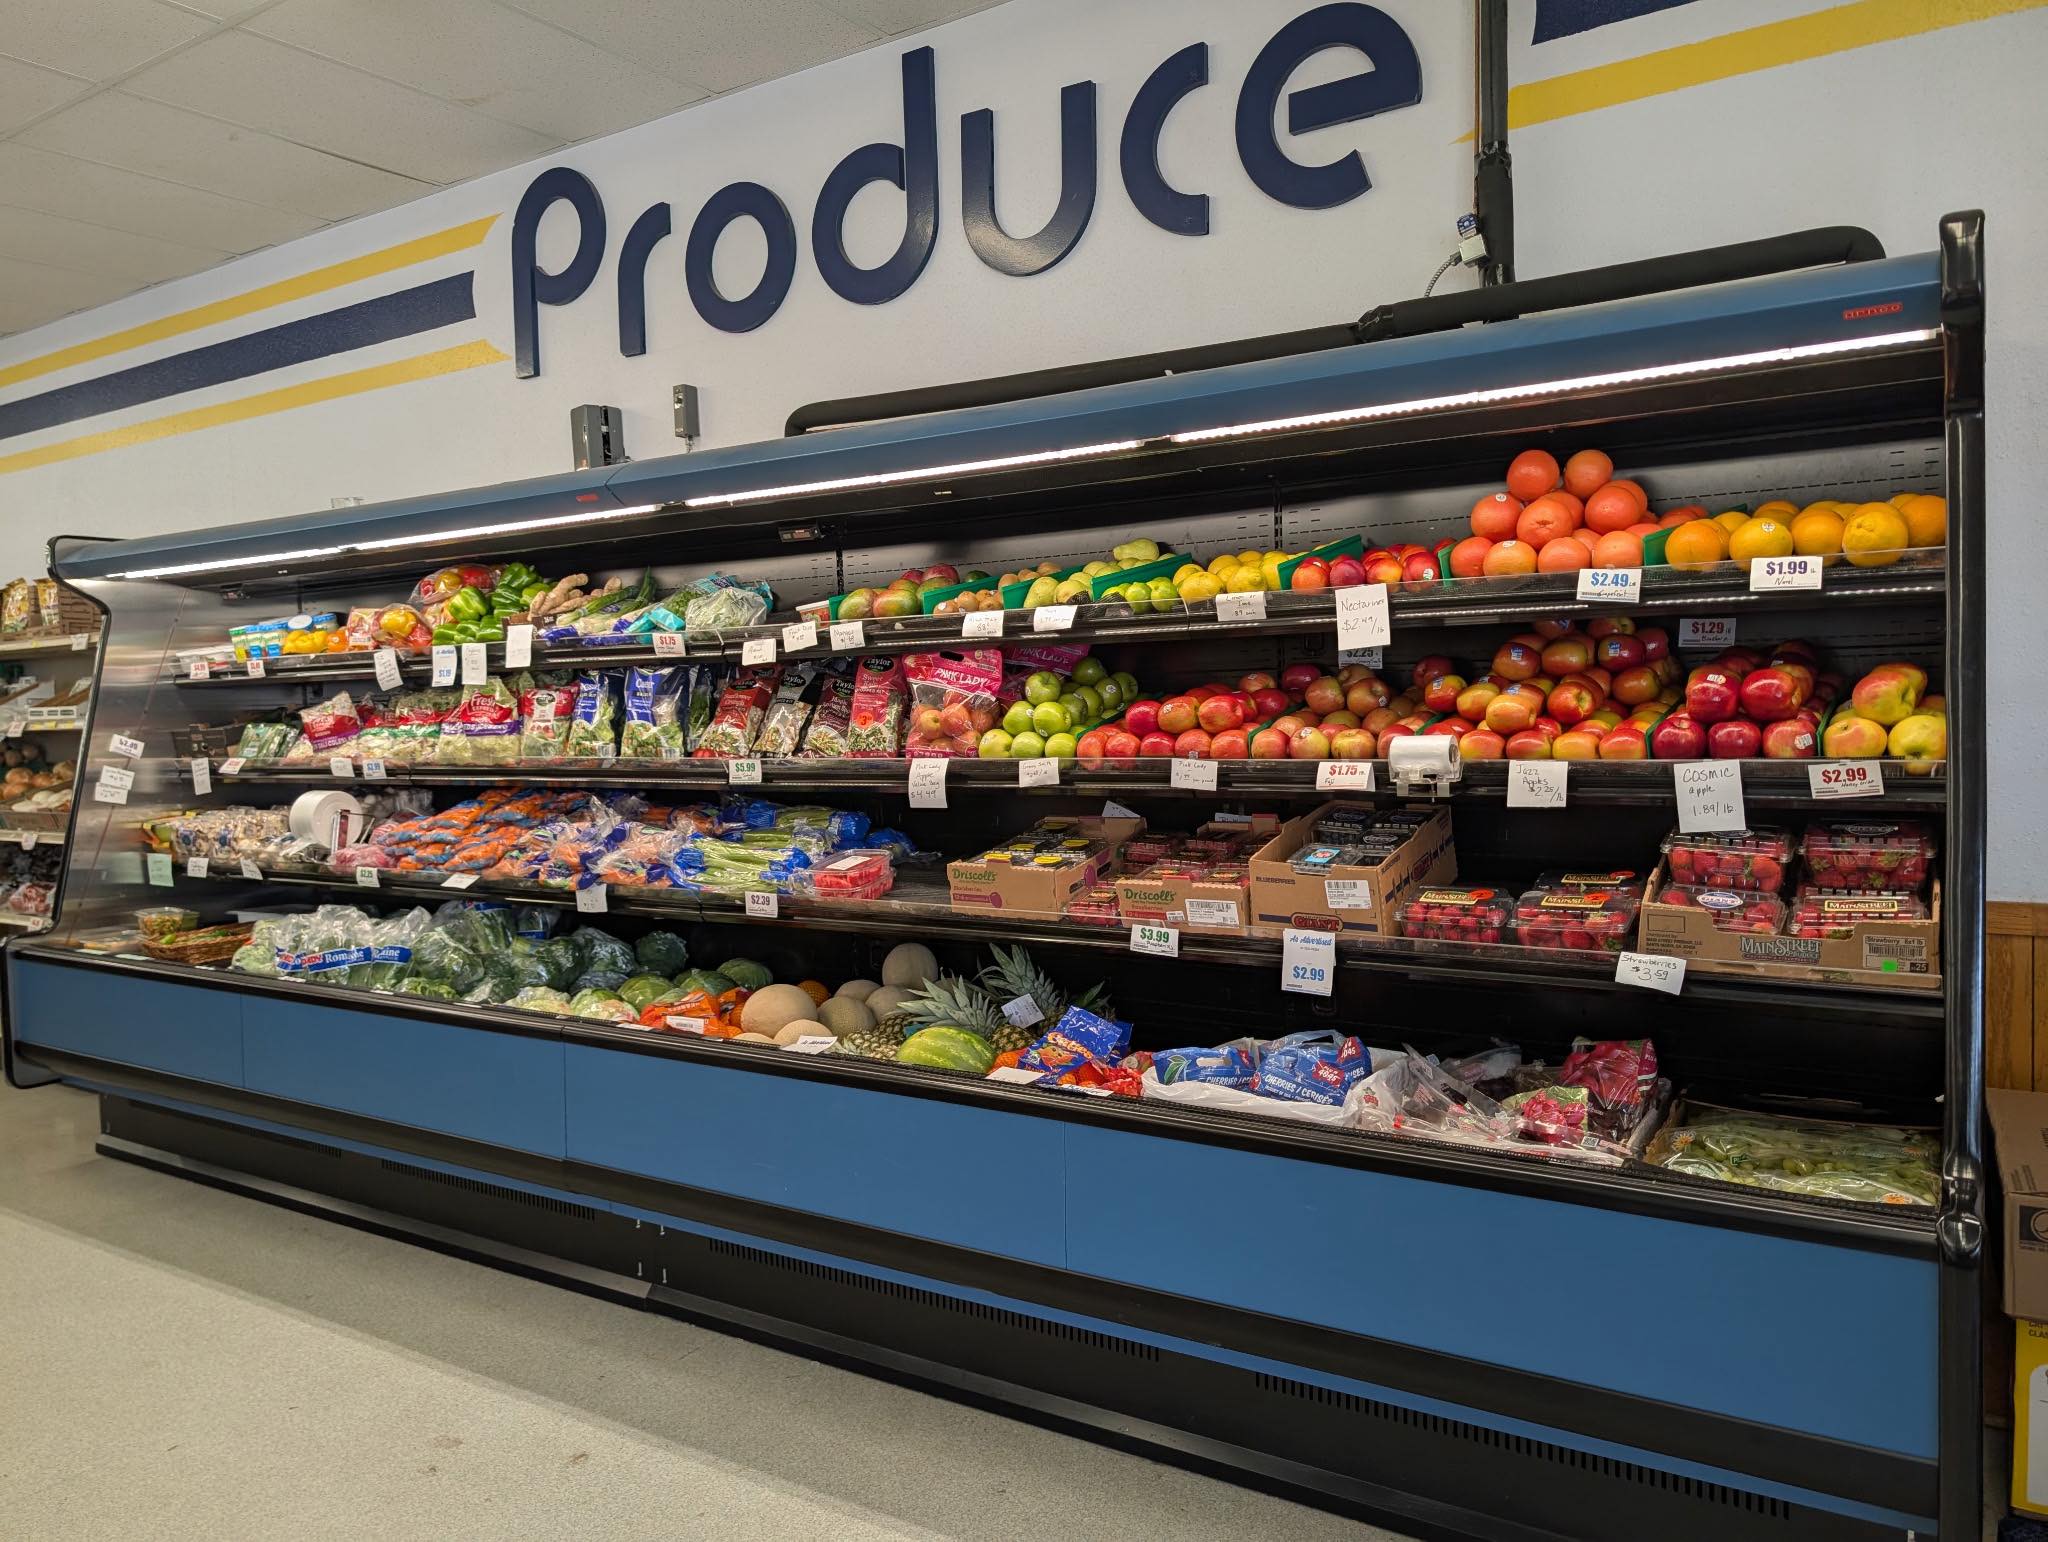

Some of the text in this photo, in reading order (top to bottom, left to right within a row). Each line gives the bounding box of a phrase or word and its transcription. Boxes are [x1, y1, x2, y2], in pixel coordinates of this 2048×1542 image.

[1766, 560, 1808, 577] $1.99
[1590, 572, 1629, 588] $2.49
[1691, 621, 1725, 634] $1.29
[836, 680, 854, 690] Taylo
[735, 762, 756, 773] $5.99
[1328, 764, 1359, 777] $1.75
[1821, 767, 1867, 785] $2.99
[750, 894, 771, 906] $2.39
[1294, 915, 1339, 932] GIANT
[1140, 927, 1170, 943] $3.99
[1621, 954, 1677, 970] Strawberries
[1292, 965, 1325, 982] $2.99
[1264, 1073, 1297, 1093] CHERRIES
